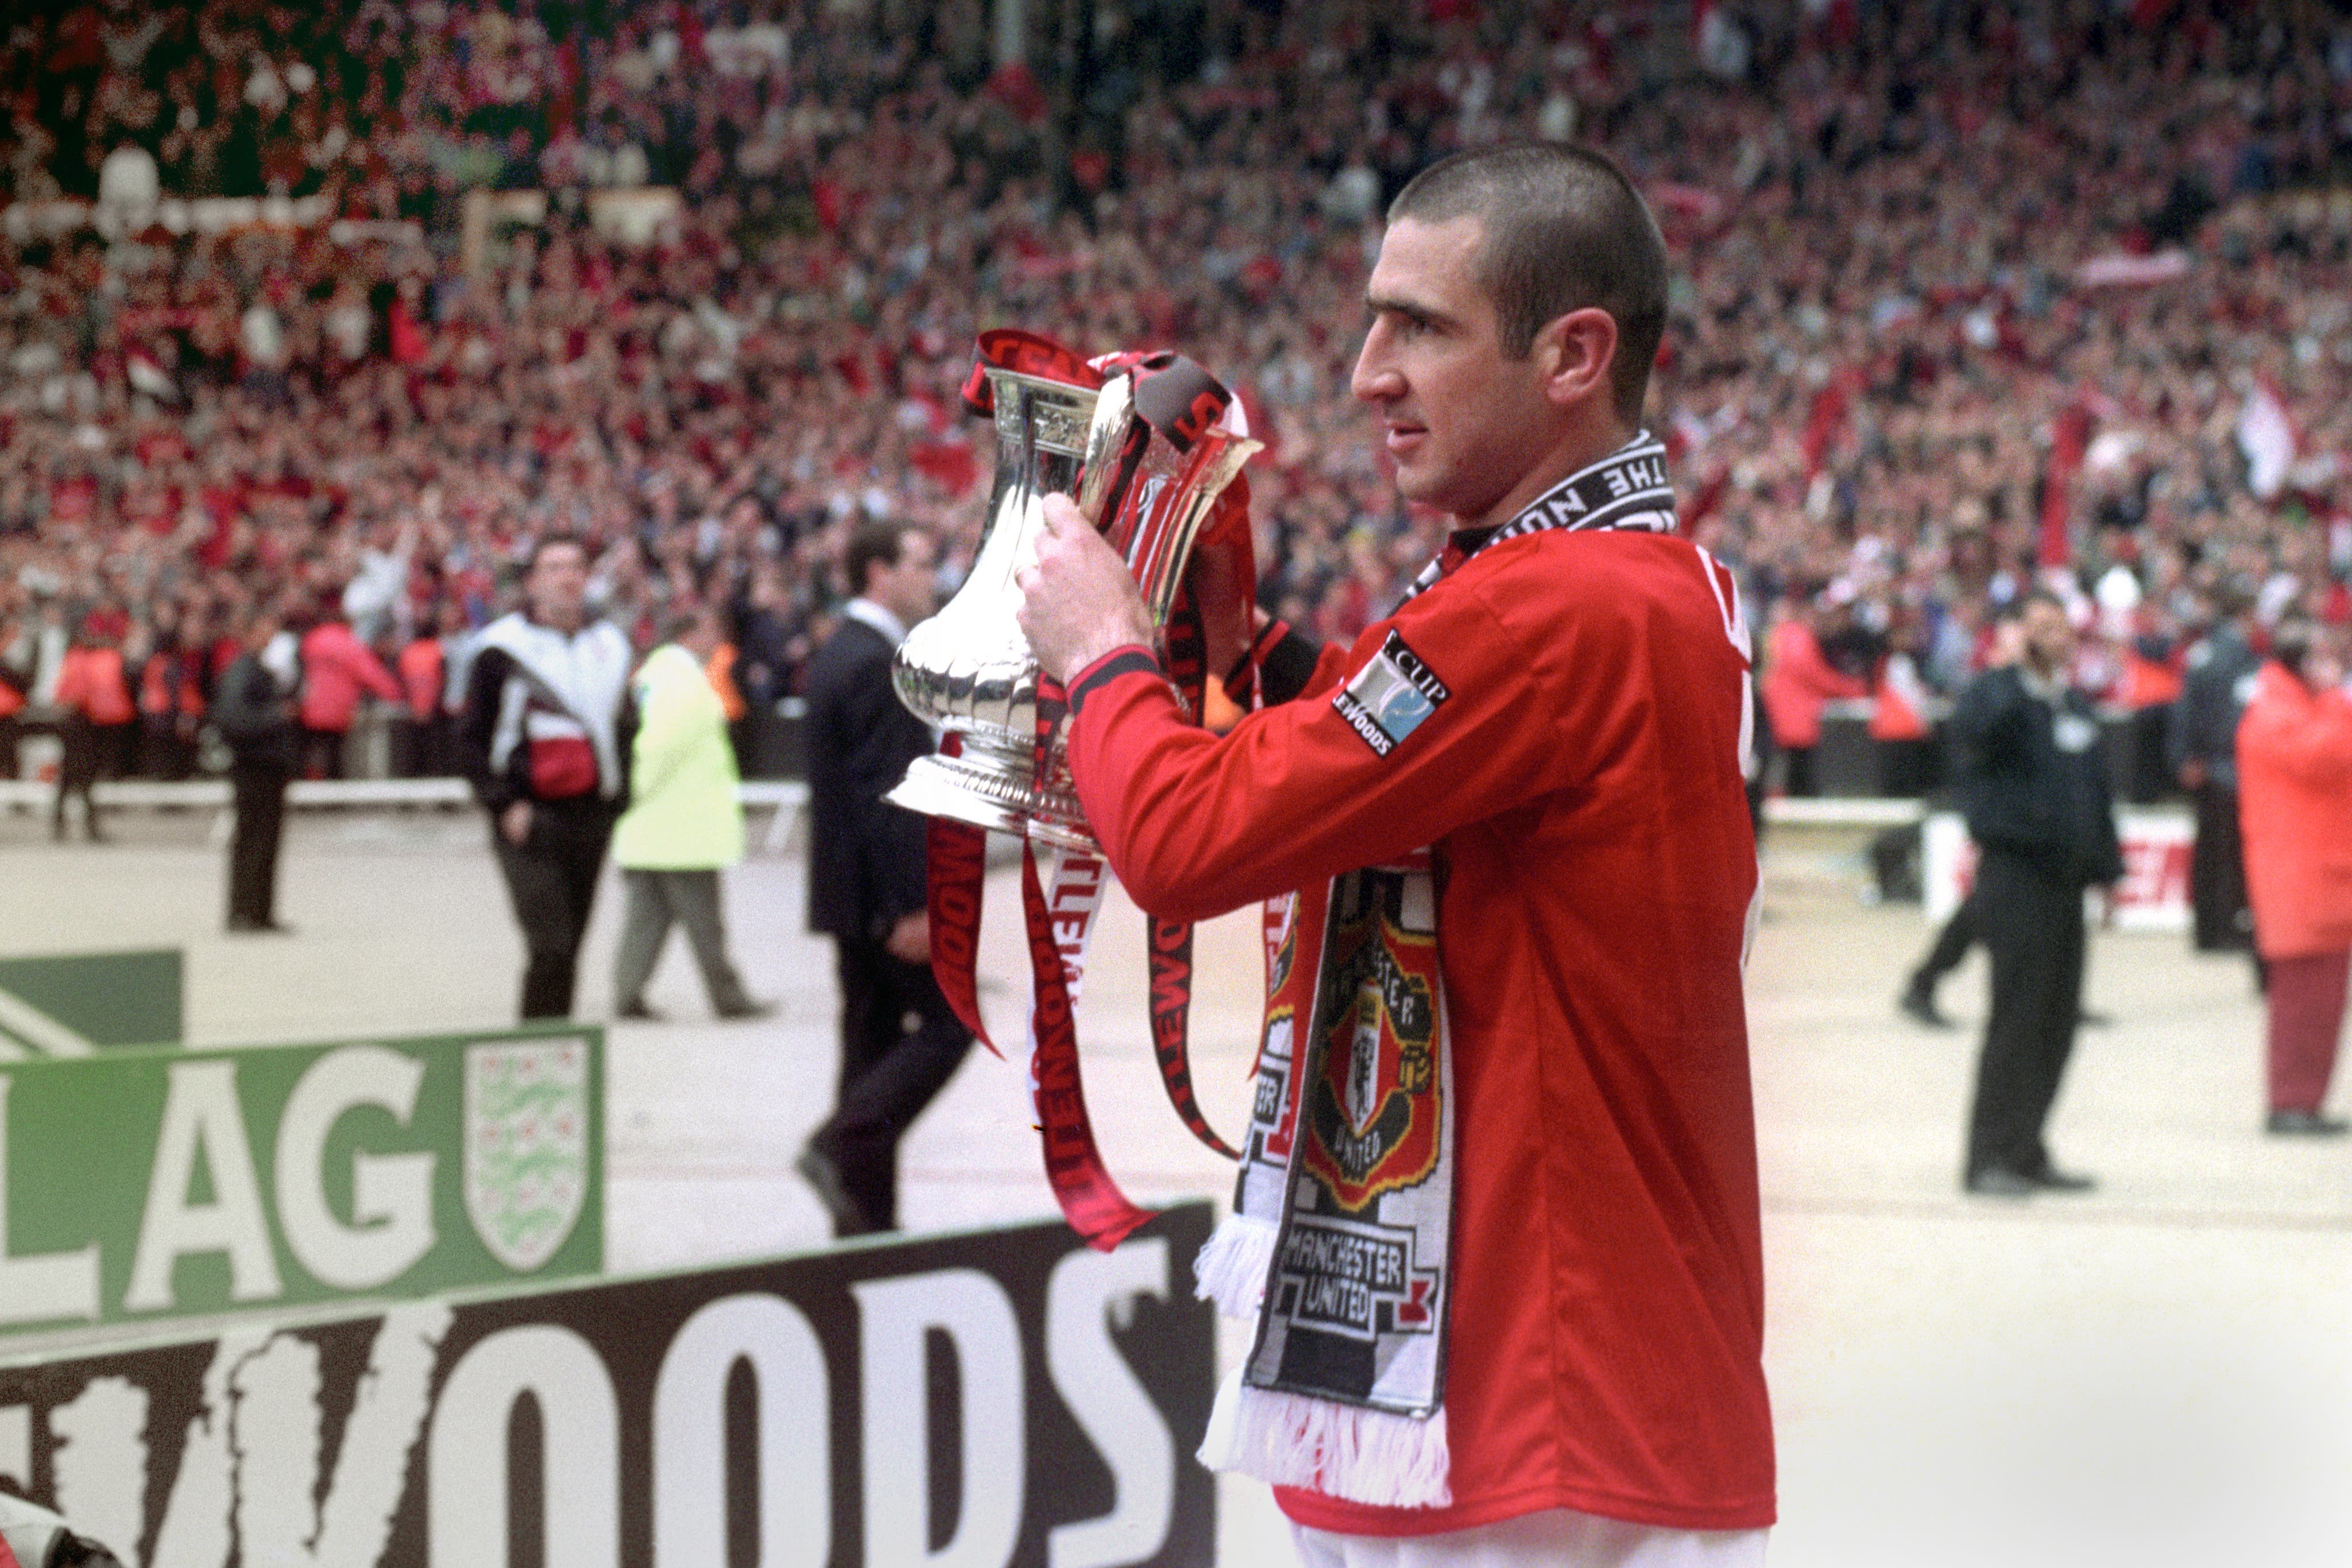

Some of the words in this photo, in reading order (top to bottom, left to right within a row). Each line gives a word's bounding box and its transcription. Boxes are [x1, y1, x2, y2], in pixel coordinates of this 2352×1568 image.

[1603, 457, 1665, 497] THE
[1395, 649, 1446, 699] CUP
[1333, 693, 1392, 756] EWOODS
[1284, 1229, 1401, 1285] MANCHESTER
[1306, 1275, 1369, 1322] UNITED
[0, 1236, 1176, 1568] WOODS
